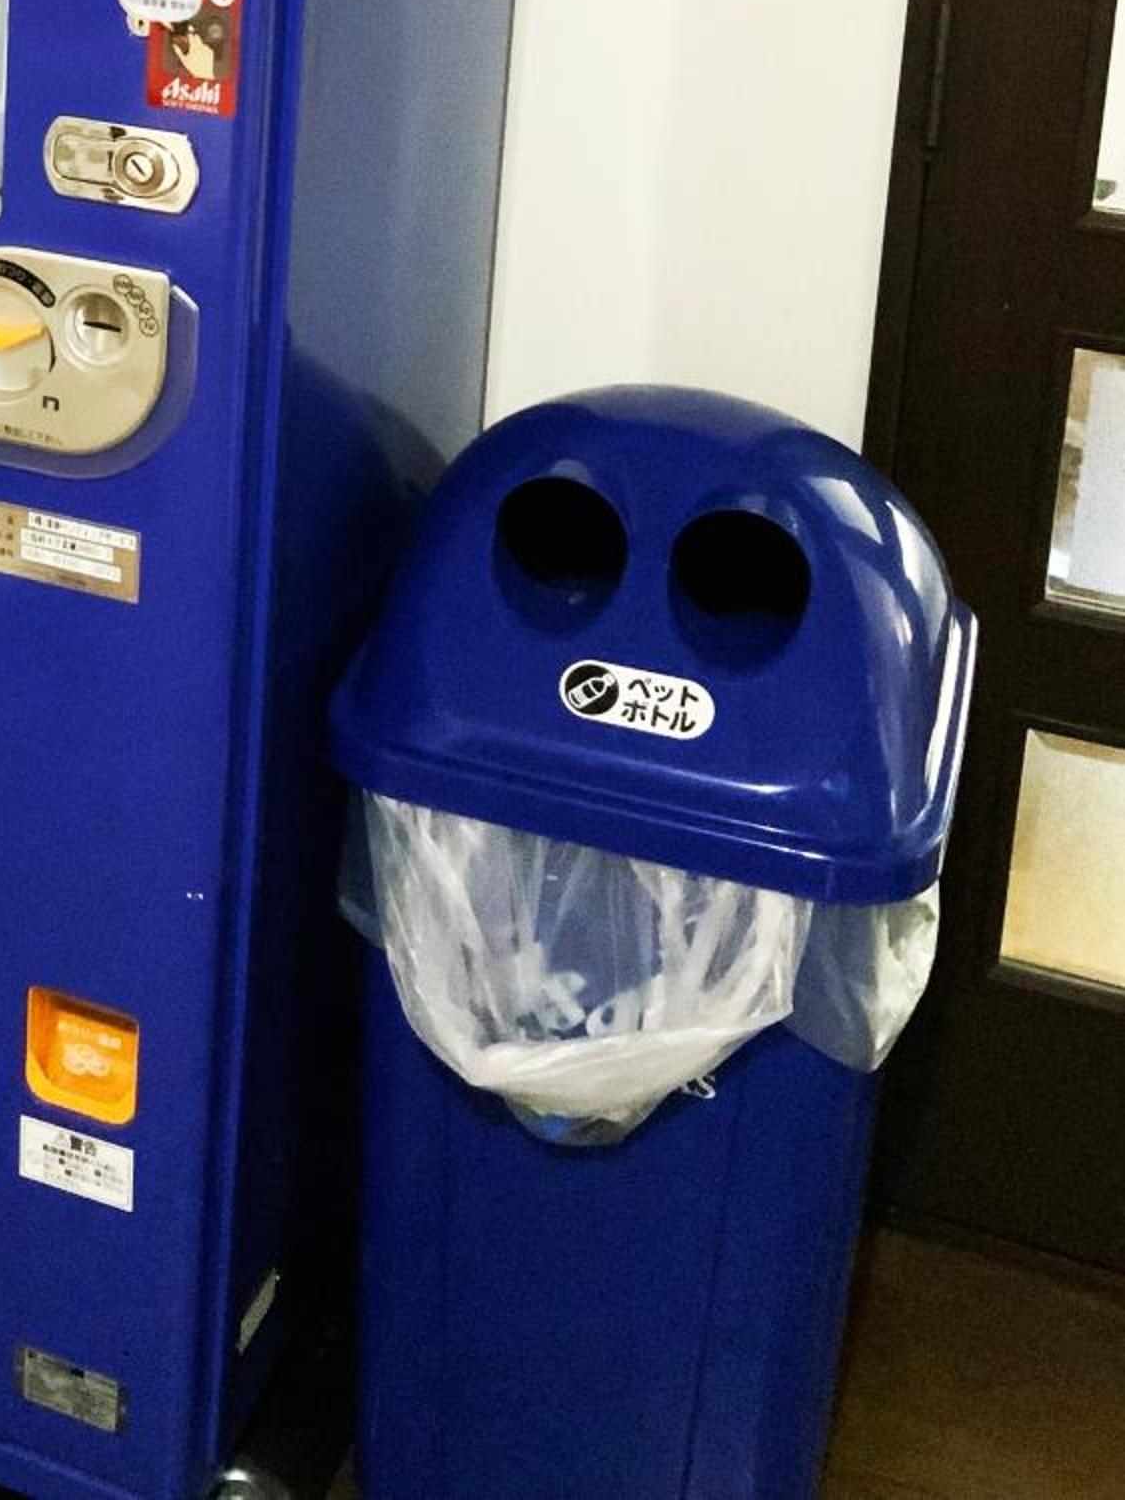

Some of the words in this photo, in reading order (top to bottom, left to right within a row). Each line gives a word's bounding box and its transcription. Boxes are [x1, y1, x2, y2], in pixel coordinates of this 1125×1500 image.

[161, 77, 221, 106] Asahi
[627, 678, 700, 708] ペット
